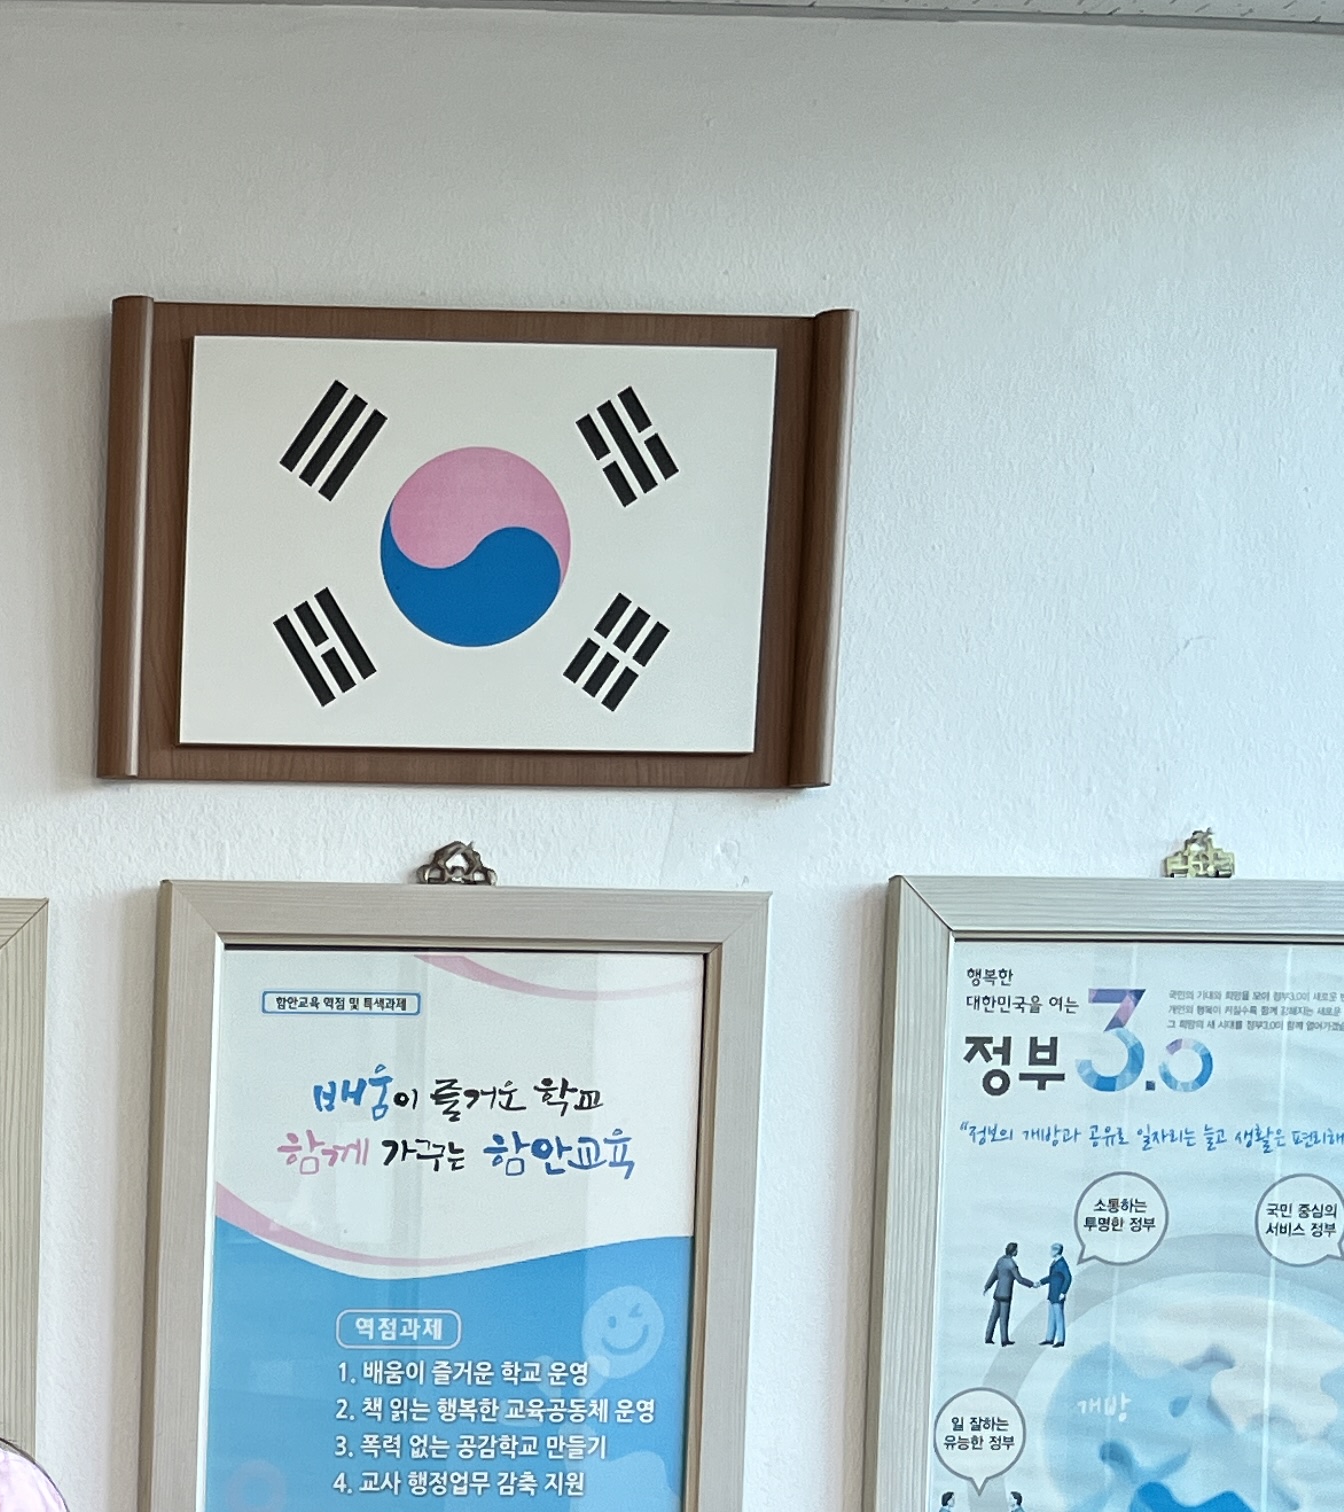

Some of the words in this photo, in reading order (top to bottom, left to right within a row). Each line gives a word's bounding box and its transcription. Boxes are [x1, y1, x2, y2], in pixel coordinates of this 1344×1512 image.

[966, 967, 1014, 987] 행복한
[275, 996, 320, 1010] 함안교육
[323, 997, 345, 1011] 역점
[349, 997, 360, 1011] 및
[363, 997, 407, 1011] 특색과제
[966, 995, 1042, 1014] 대한민국을
[1048, 996, 1079, 1014] 여는
[313, 1063, 418, 1122] 배움이
[429, 1078, 527, 1122] 즐거운
[533, 1077, 604, 1117] 학교
[1022, 1128, 1081, 1147] 개방과
[1088, 1123, 1129, 1148] 공유로
[1137, 1125, 1196, 1151] 일자리는
[1203, 1124, 1227, 1151] 늘고
[1235, 1124, 1286, 1153] 생활은
[278, 1129, 370, 1175] 함께
[381, 1138, 465, 1172] 가꾸는
[483, 1128, 636, 1180] 함안교육
[1093, 1198, 1147, 1213] 소통하는
[1267, 1202, 1293, 1219] 국민
[1298, 1203, 1337, 1219] 중심의
[1083, 1215, 1124, 1233] 투명한
[1129, 1215, 1156, 1233] 정부
[1266, 1220, 1305, 1237] 서비스
[1311, 1220, 1337, 1237] 정부
[355, 1317, 443, 1341] 역점과제
[338, 1361, 356, 1384] 1.
[362, 1360, 425, 1385] 배움이
[432, 1360, 494, 1385] 즐거운
[501, 1361, 542, 1386] 학교
[547, 1361, 589, 1387] 운영
[335, 1399, 355, 1421] 2.
[361, 1397, 382, 1421] 책
[389, 1397, 431, 1422] 읽는
[437, 1398, 499, 1423] 행복한
[504, 1398, 609, 1423] 교육공동체
[614, 1398, 655, 1423] 운영
[1077, 1392, 1132, 1423] 개방
[951, 1416, 964, 1432] 일
[970, 1416, 1009, 1432] 잘하는
[335, 1435, 354, 1458] 3.
[360, 1434, 402, 1458] 폭력
[409, 1434, 450, 1459] 없는
[456, 1435, 539, 1459] 공감학교
[546, 1435, 607, 1459] 만들기
[943, 1435, 984, 1450] 유능한
[988, 1435, 1015, 1450] 정부
[332, 1472, 352, 1494] 4.
[359, 1471, 401, 1495] 교사
[407, 1471, 490, 1495] 행정업무
[497, 1471, 538, 1496] 감축
[544, 1472, 585, 1497] 지원
